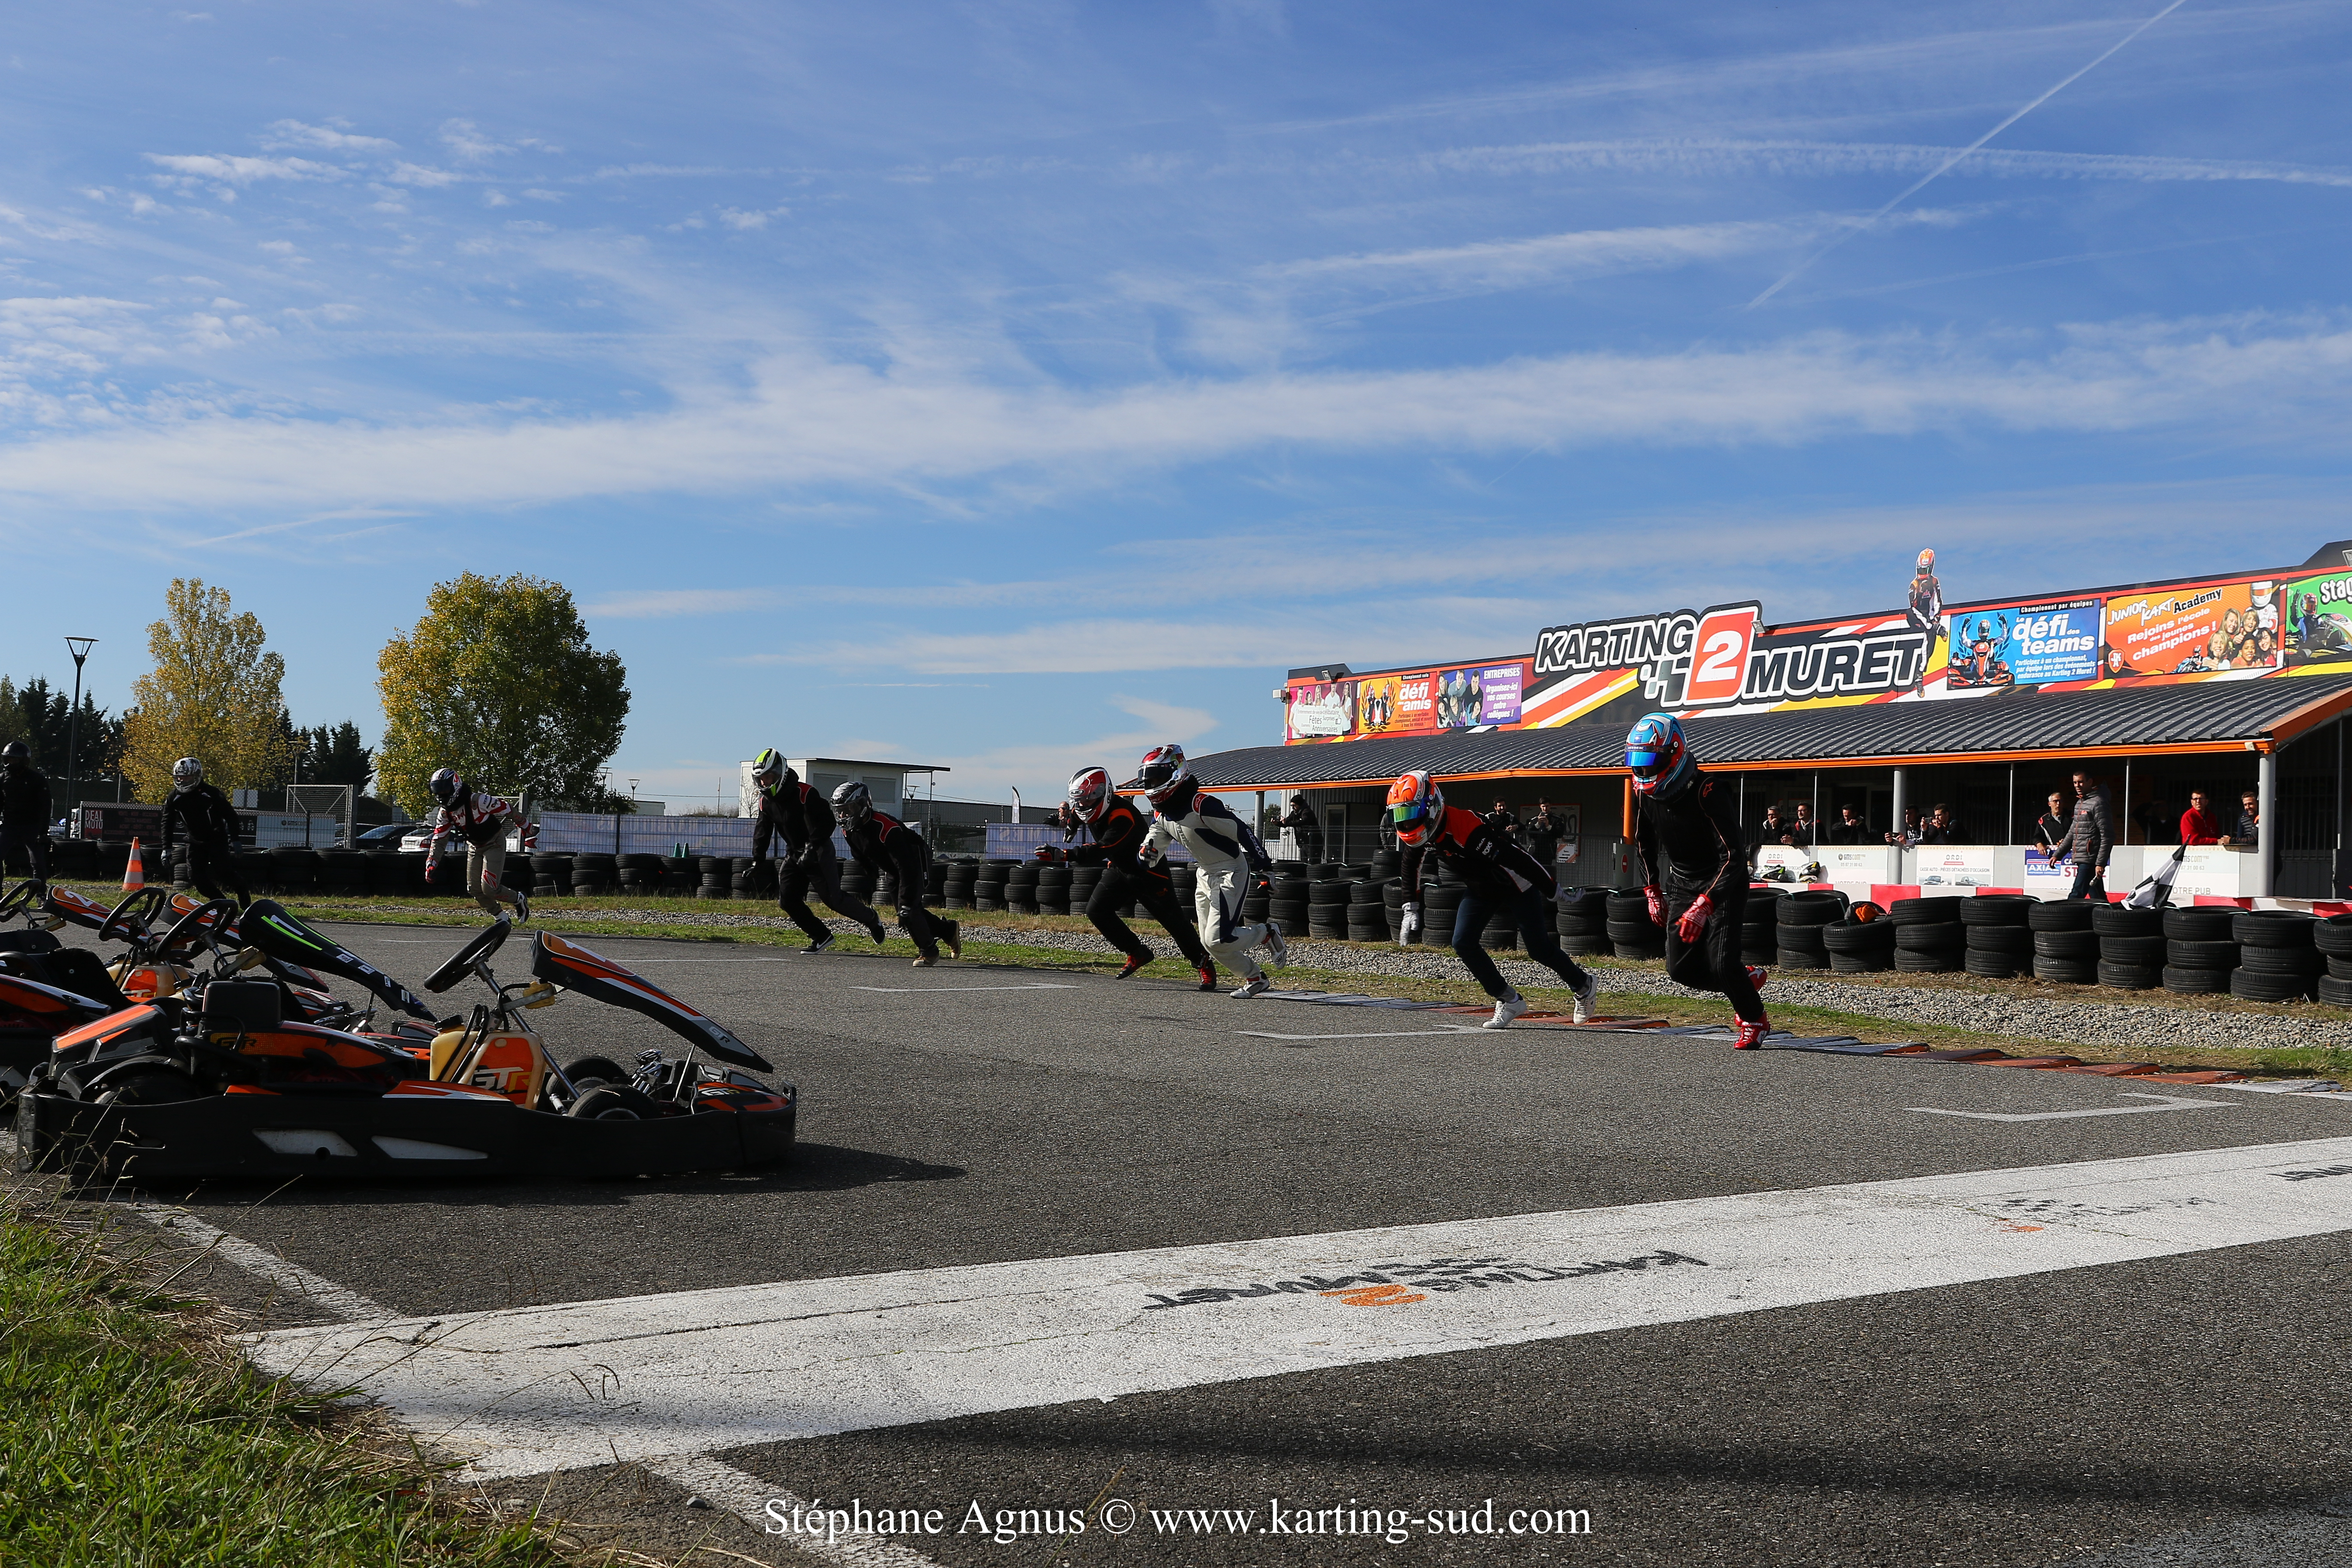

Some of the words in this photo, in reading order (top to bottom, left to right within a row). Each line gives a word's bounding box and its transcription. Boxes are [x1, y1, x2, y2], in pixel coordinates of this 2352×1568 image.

[2021, 604, 2057, 613] Championnat
[2107, 599, 2148, 625] JUNIOR
[2141, 597, 2175, 626] KART
[2173, 588, 2222, 614] Academy
[2012, 613, 2070, 640] défi
[2127, 620, 2175, 644] Rejoins
[2161, 623, 2194, 641] jeunes
[2021, 635, 2095, 655] teams
[2132, 625, 2210, 661] champions
[1537, 615, 1693, 673] KARTING
[1696, 630, 1743, 683] 2
[1746, 640, 1923, 695] MURET
[1483, 667, 1520, 680] ENTREPRISES
[1399, 682, 1430, 700] défi
[1485, 682, 1519, 694] Organisez-ici
[1496, 692, 1516, 701] courses
[1402, 697, 1432, 712] amis
[1493, 701, 1507, 710] entre
[1309, 715, 1322, 724] Fêtes
[1487, 710, 1510, 720] collègues
[85, 810, 104, 821] DEAL
[85, 819, 104, 830] MOTO
[1408, 1249, 1709, 1292] KARTING
[1142, 1269, 1393, 1310] MURET
[1320, 1283, 1427, 1308] 2
